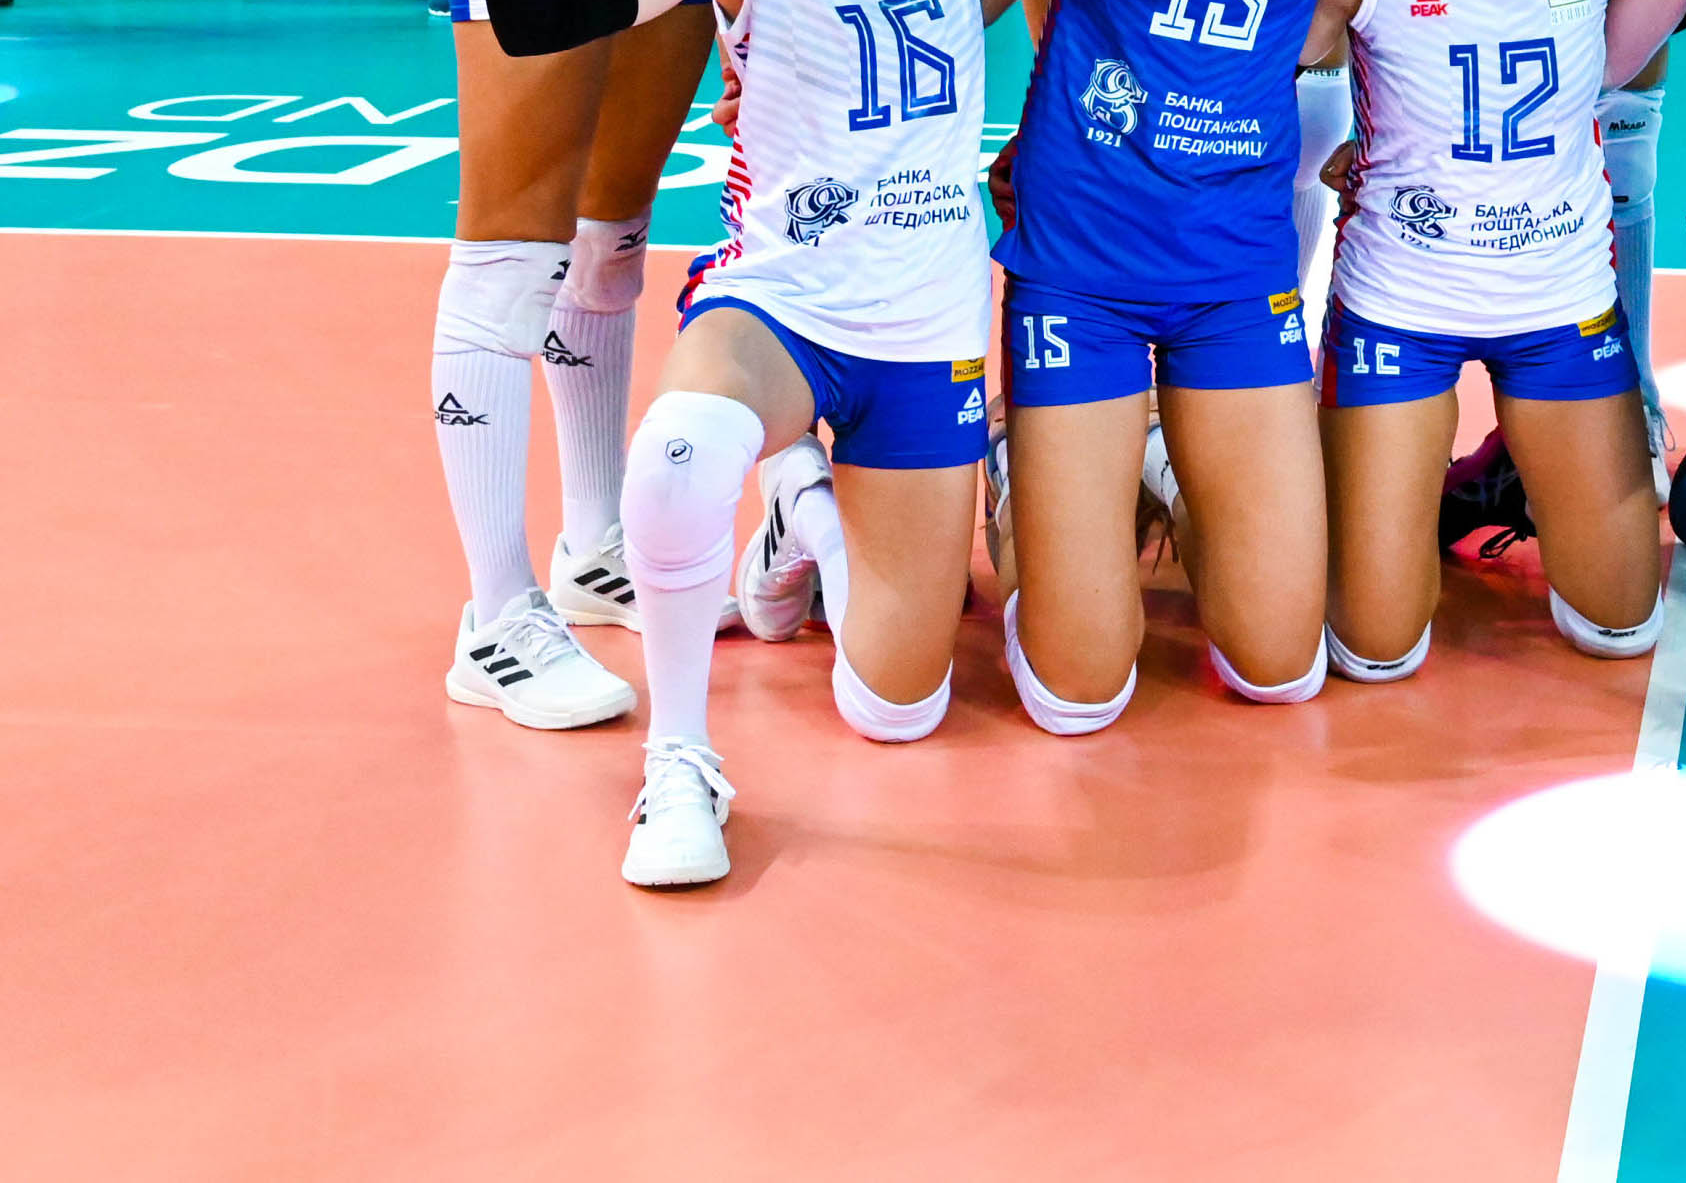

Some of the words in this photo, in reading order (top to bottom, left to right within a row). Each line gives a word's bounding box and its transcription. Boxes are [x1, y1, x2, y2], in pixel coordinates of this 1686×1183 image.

[1411, 2, 1448, 17] PEAK
[1164, 91, 1223, 115] БАНКА
[1448, 37, 1560, 163] 12
[1157, 111, 1262, 135] ПОШТАНСКА
[1086, 126, 1122, 148] 1921
[870, 183, 966, 208] ПОШТАСКА
[1474, 201, 1532, 218] БАНКА
[1470, 216, 1585, 252] ШТЕДИОНИЦА
[1022, 314, 1070, 369] 15
[1593, 339, 1624, 362] PEAK
[543, 350, 595, 368] EAK
